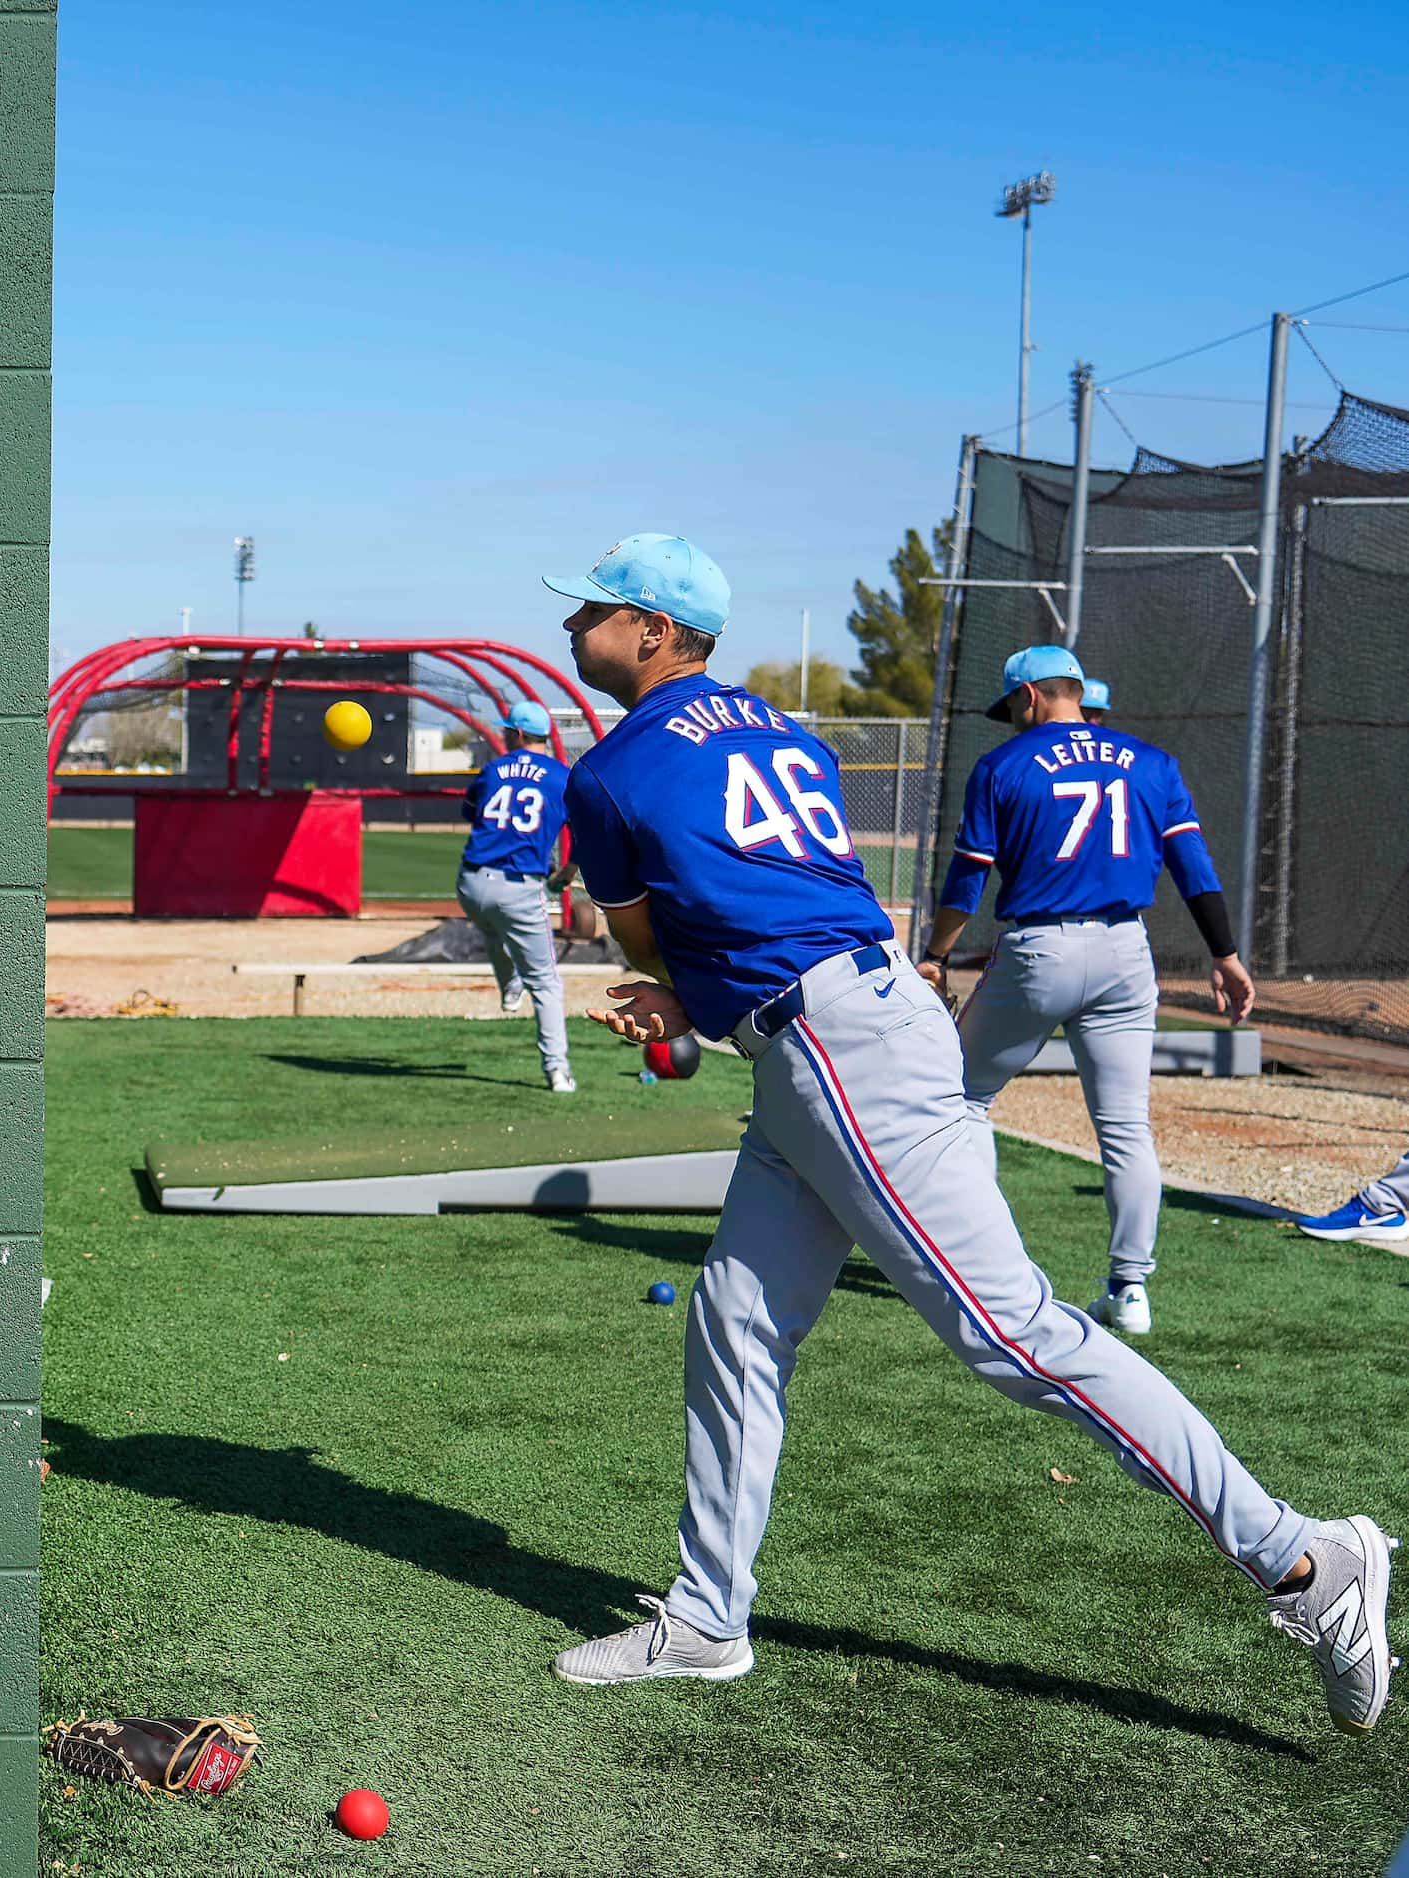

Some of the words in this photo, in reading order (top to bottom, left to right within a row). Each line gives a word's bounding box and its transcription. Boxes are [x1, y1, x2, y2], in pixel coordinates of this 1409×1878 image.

[664, 695, 792, 746] BURKE
[496, 763, 548, 783] WHITE
[1033, 740, 1135, 774] LEITER
[483, 785, 545, 834] 43
[722, 747, 855, 861] 46
[1052, 778, 1130, 861] 71
